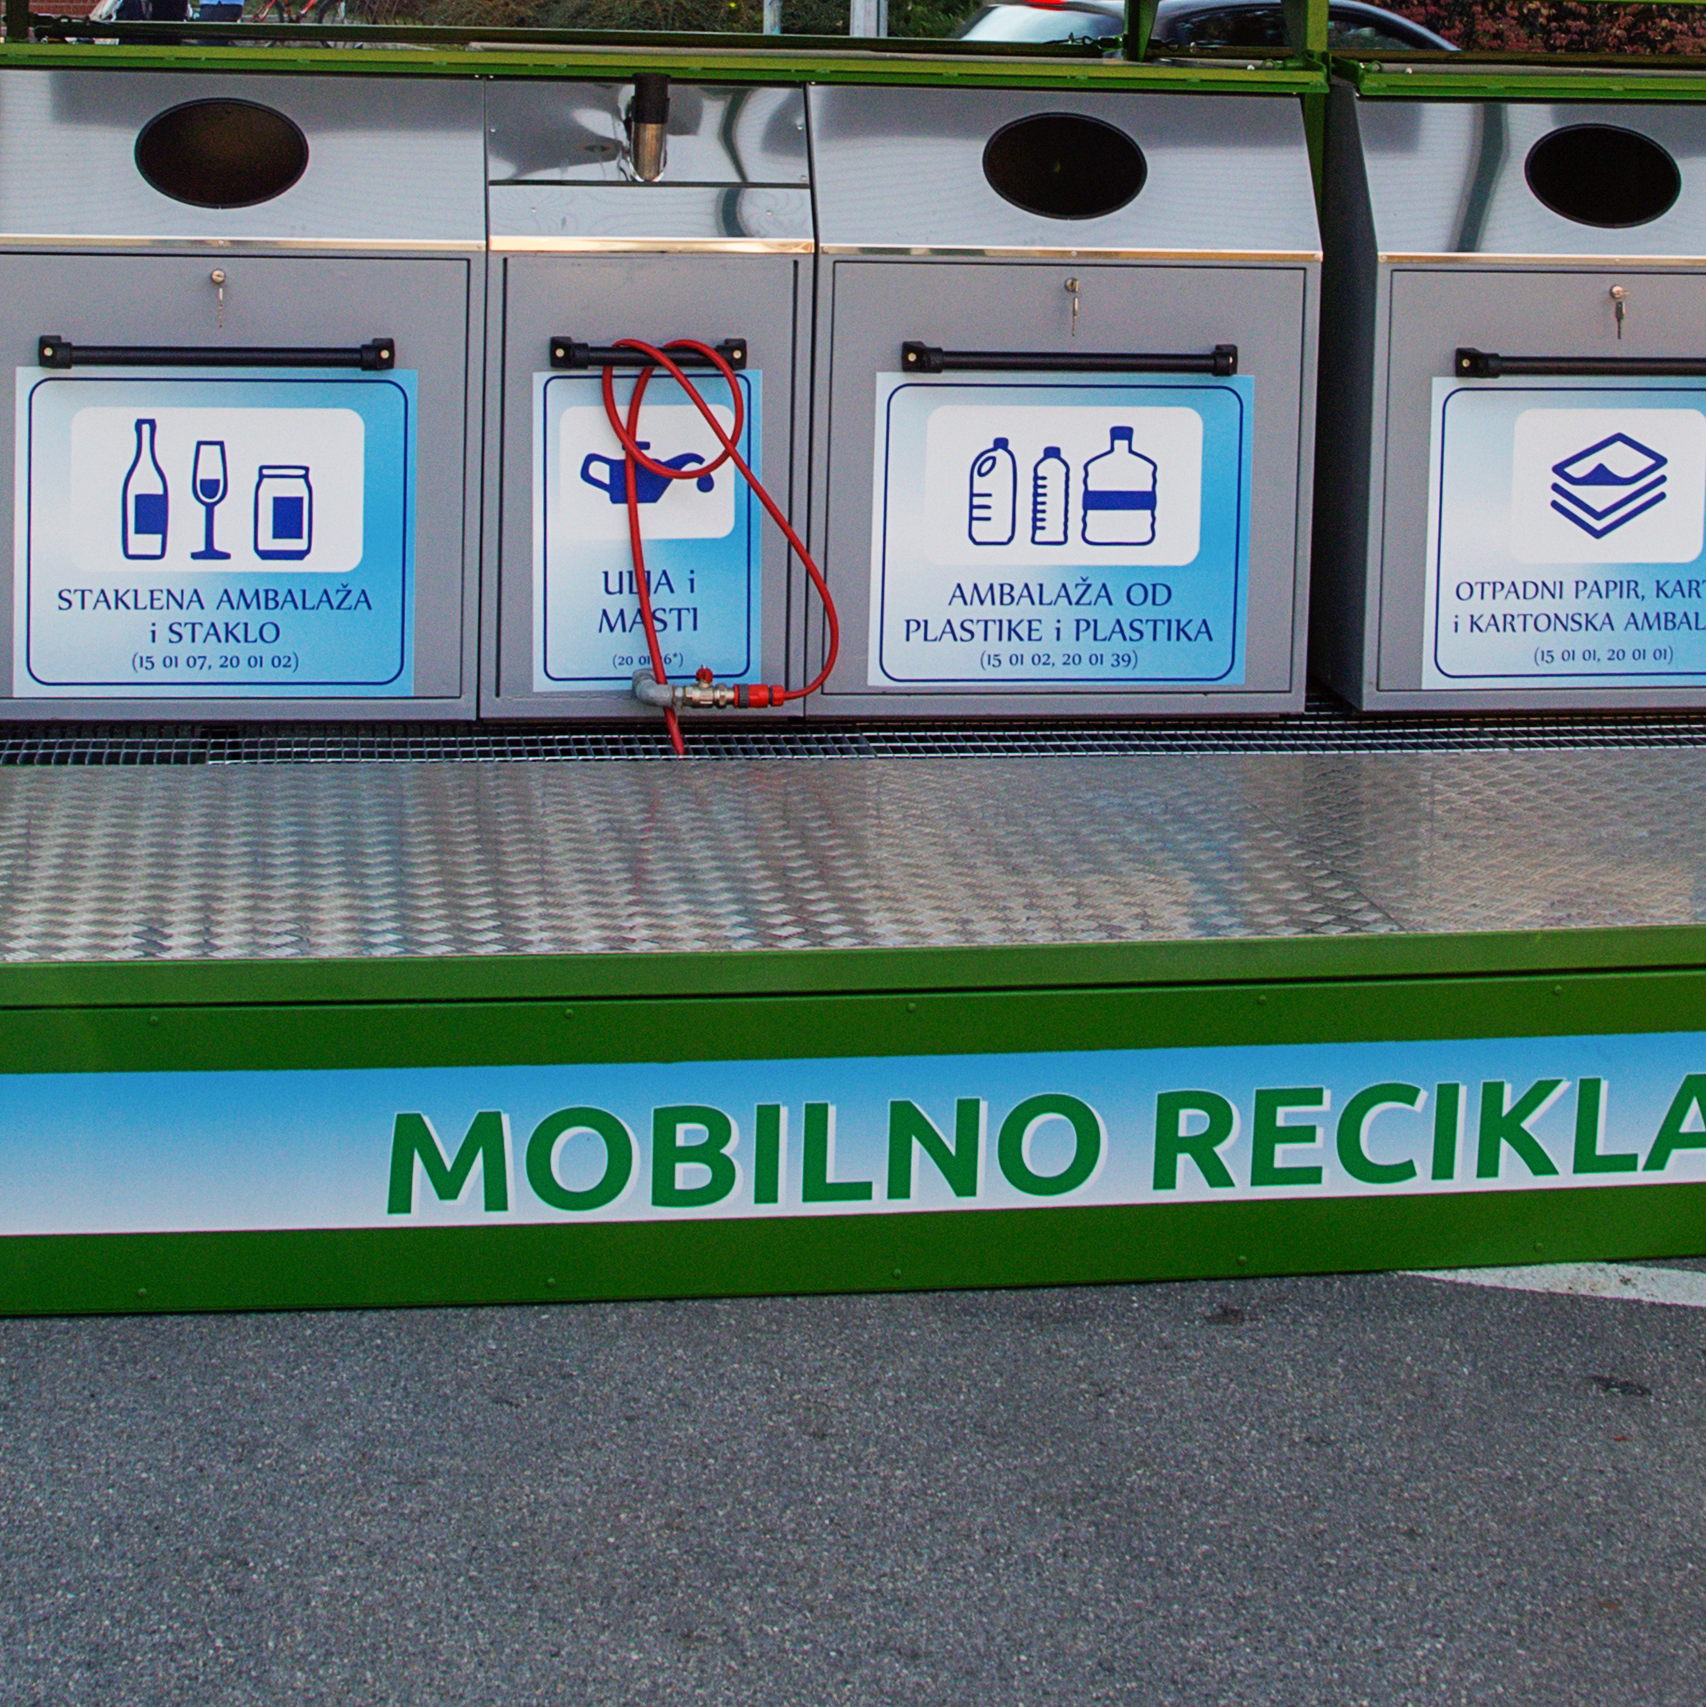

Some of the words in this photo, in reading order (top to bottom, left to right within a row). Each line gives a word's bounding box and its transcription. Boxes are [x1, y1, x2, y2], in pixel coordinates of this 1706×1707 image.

[602, 569, 675, 597] ULJA
[688, 569, 695, 594] i
[948, 577, 1113, 607] AMBALAŽA
[1126, 582, 1172, 606] OD
[1455, 580, 1565, 602] OTPADNI
[1574, 580, 1646, 604] PAPIR,
[58, 587, 205, 612] STAKLENA
[216, 581, 372, 612] AMBALAŽA
[150, 621, 157, 644] i
[167, 620, 281, 645] STAKLO
[598, 607, 698, 633] MASTI
[904, 618, 1043, 643] PLASTIKE
[1053, 620, 1062, 642] i
[1074, 619, 1213, 642] PLASTIKA
[1453, 615, 1459, 634] i
[1469, 611, 1614, 634] KARTONSKA
[132, 652, 154, 673] (15
[162, 654, 179, 668] 01
[186, 654, 213, 672] 07,
[219, 654, 238, 668] 20
[245, 654, 260, 668] 01
[269, 652, 299, 673] 02)
[613, 654, 633, 668] (20
[980, 651, 1002, 671] (15
[1009, 653, 1026, 666] 01
[1030, 653, 1056, 670] 02,
[1061, 653, 1082, 666] 20
[1088, 653, 1104, 666] 01
[1111, 651, 1138, 671] 39)
[1534, 647, 1554, 666] (15
[1561, 649, 1575, 662] 01
[1581, 649, 1602, 665] 01,
[1607, 649, 1626, 662] 20
[1631, 649, 1646, 662] 01
[1652, 647, 1673, 665] 01)
[381, 1089, 1104, 1219] MOBILNO
